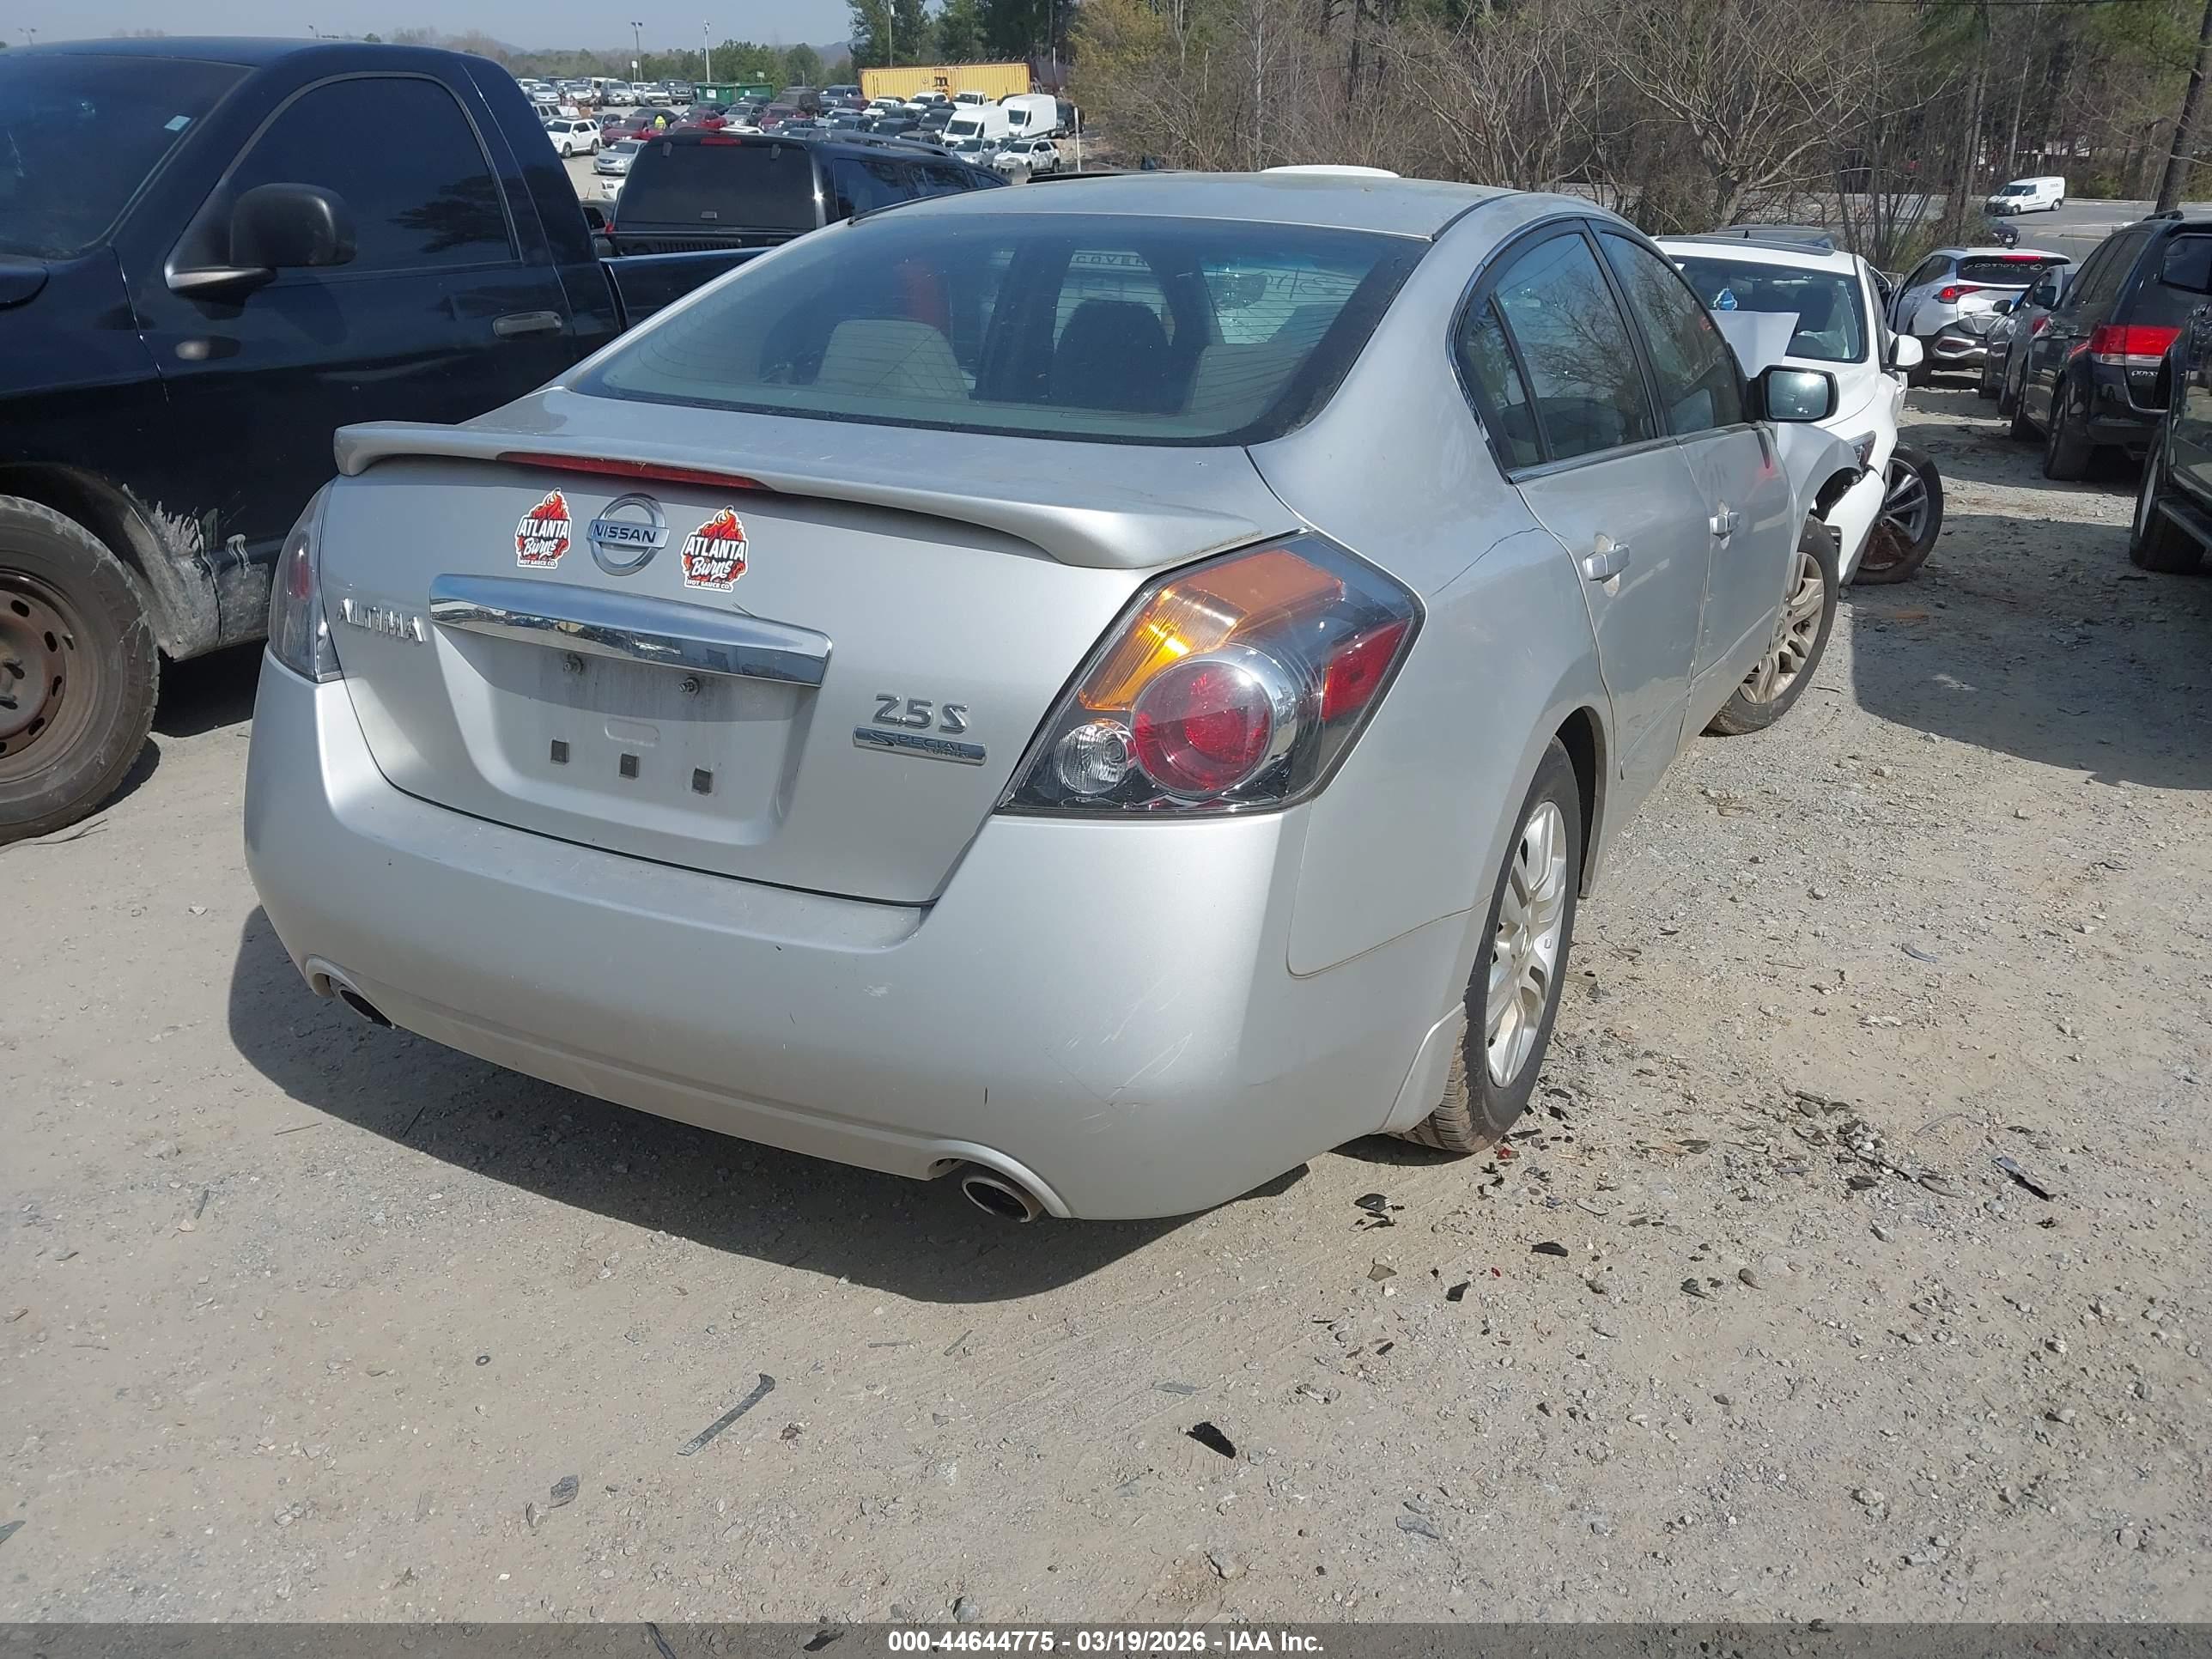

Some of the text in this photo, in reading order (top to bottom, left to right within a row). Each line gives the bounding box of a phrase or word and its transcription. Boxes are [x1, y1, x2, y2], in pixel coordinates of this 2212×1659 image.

[518, 519, 569, 538] ATLANTA
[592, 524, 656, 544] NISSAN
[524, 538, 558, 556] Burns
[684, 537, 745, 561] ATLANTA
[692, 556, 733, 578] Burns
[337, 599, 427, 642] ALTIMA
[873, 694, 969, 734] 2.5 S
[870, 732, 969, 753] SPECIAL
